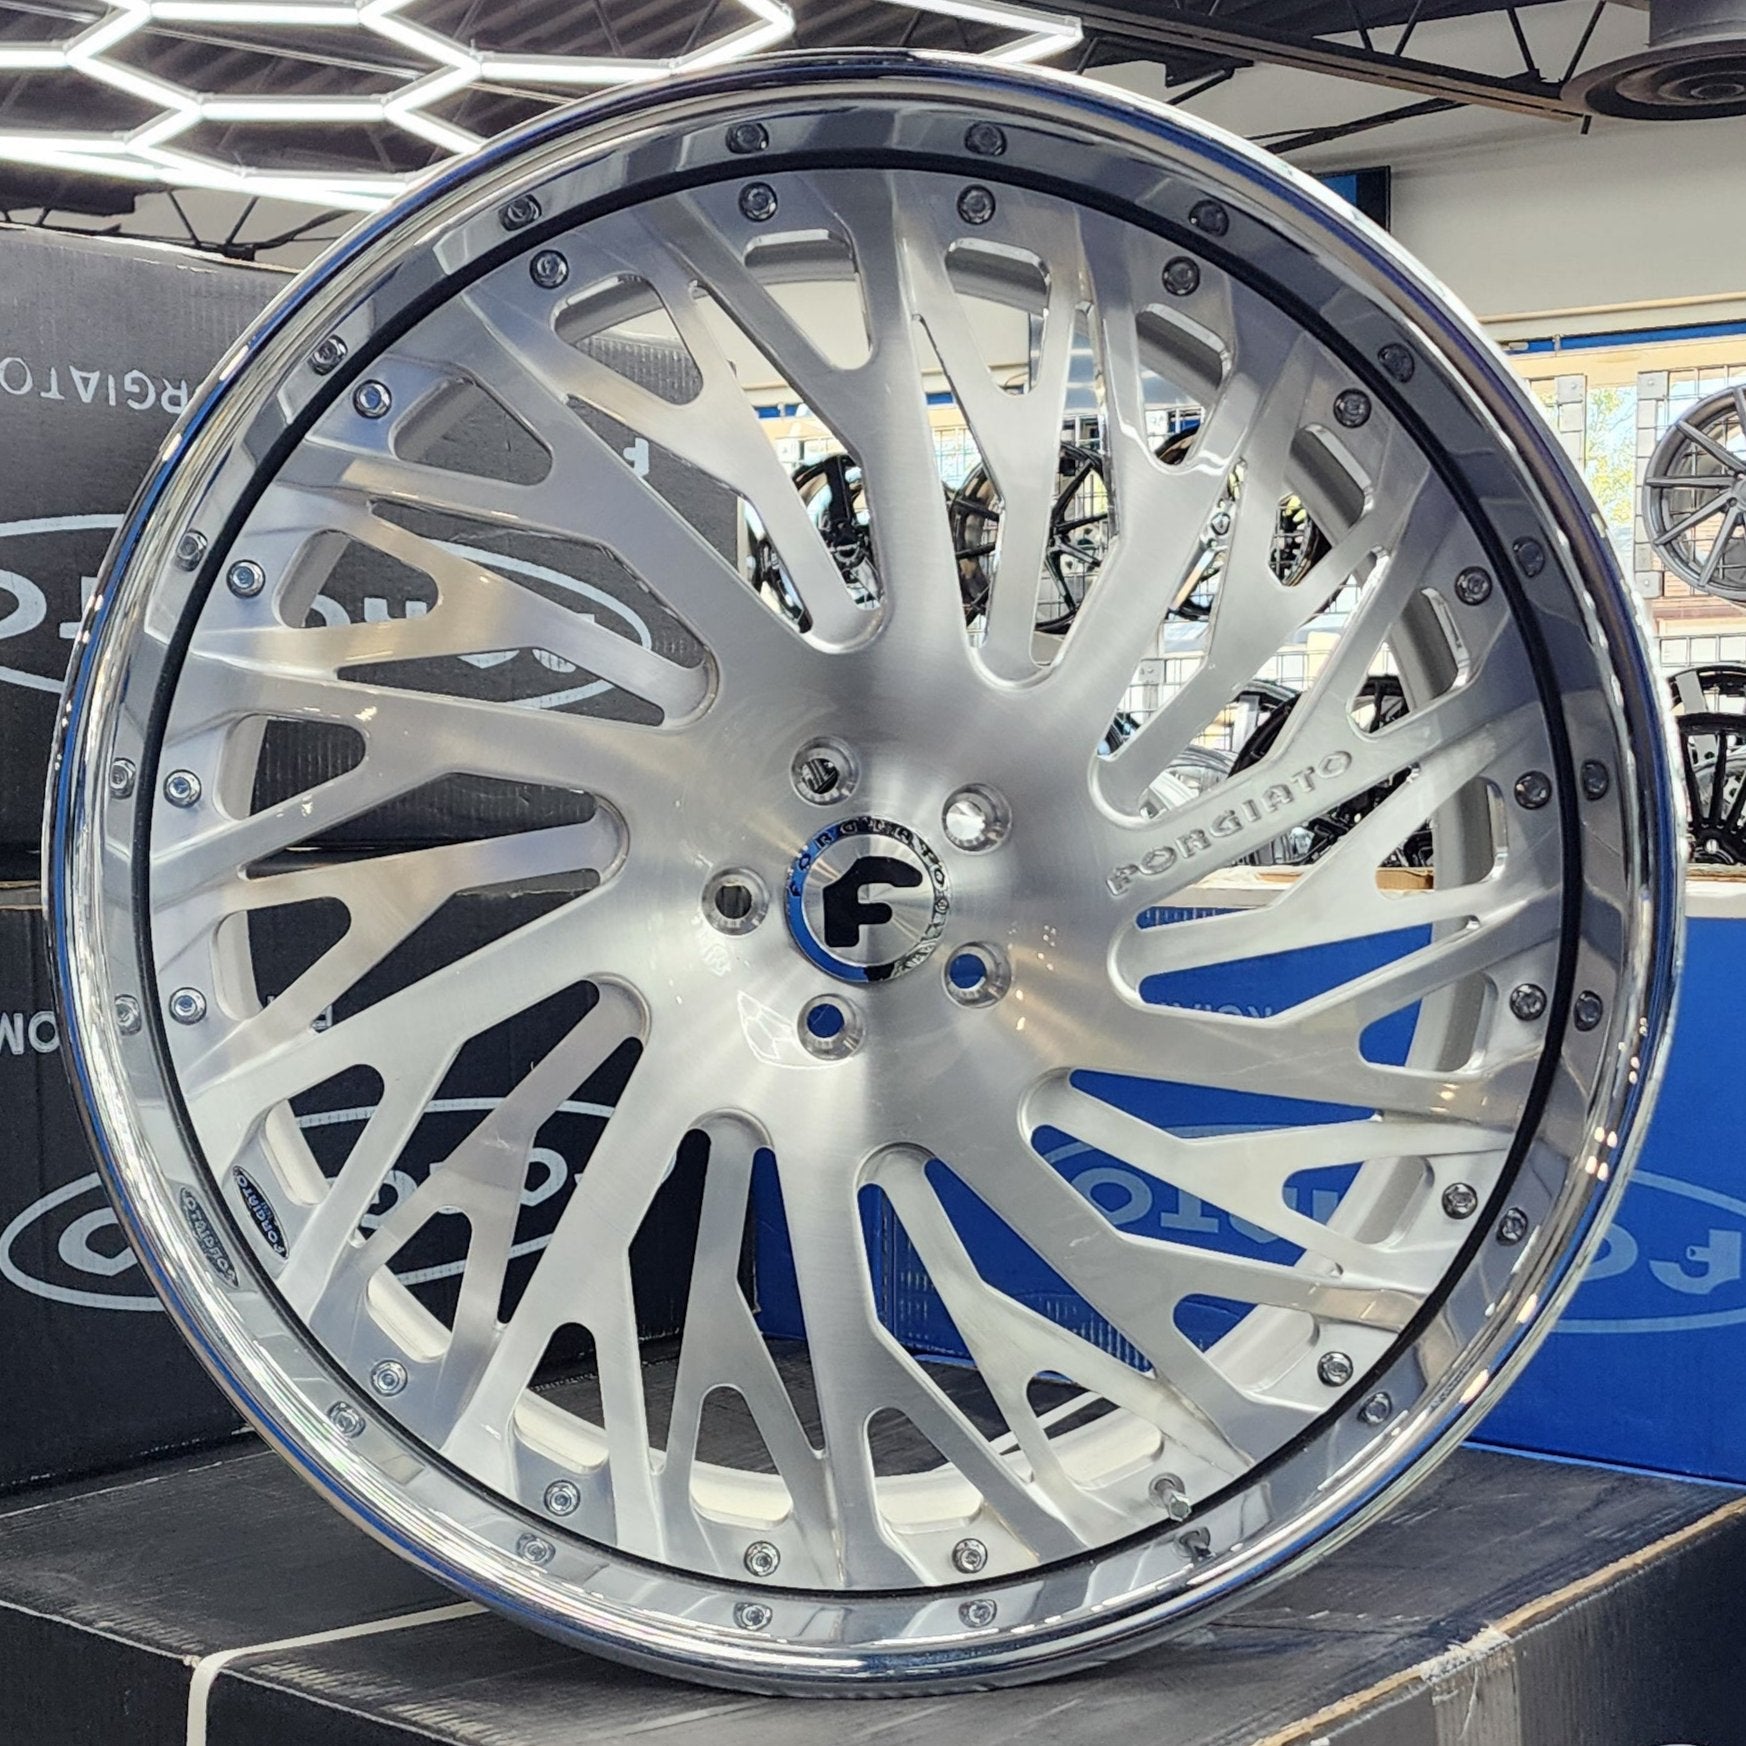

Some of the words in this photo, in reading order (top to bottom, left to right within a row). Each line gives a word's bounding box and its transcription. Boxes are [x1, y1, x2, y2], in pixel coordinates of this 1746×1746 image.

[0, 357, 189, 414] RGIATO
[1106, 751, 1351, 896] FORGIATO
[823, 856, 923, 947] F
[236, 1173, 286, 1254] FORGIATO
